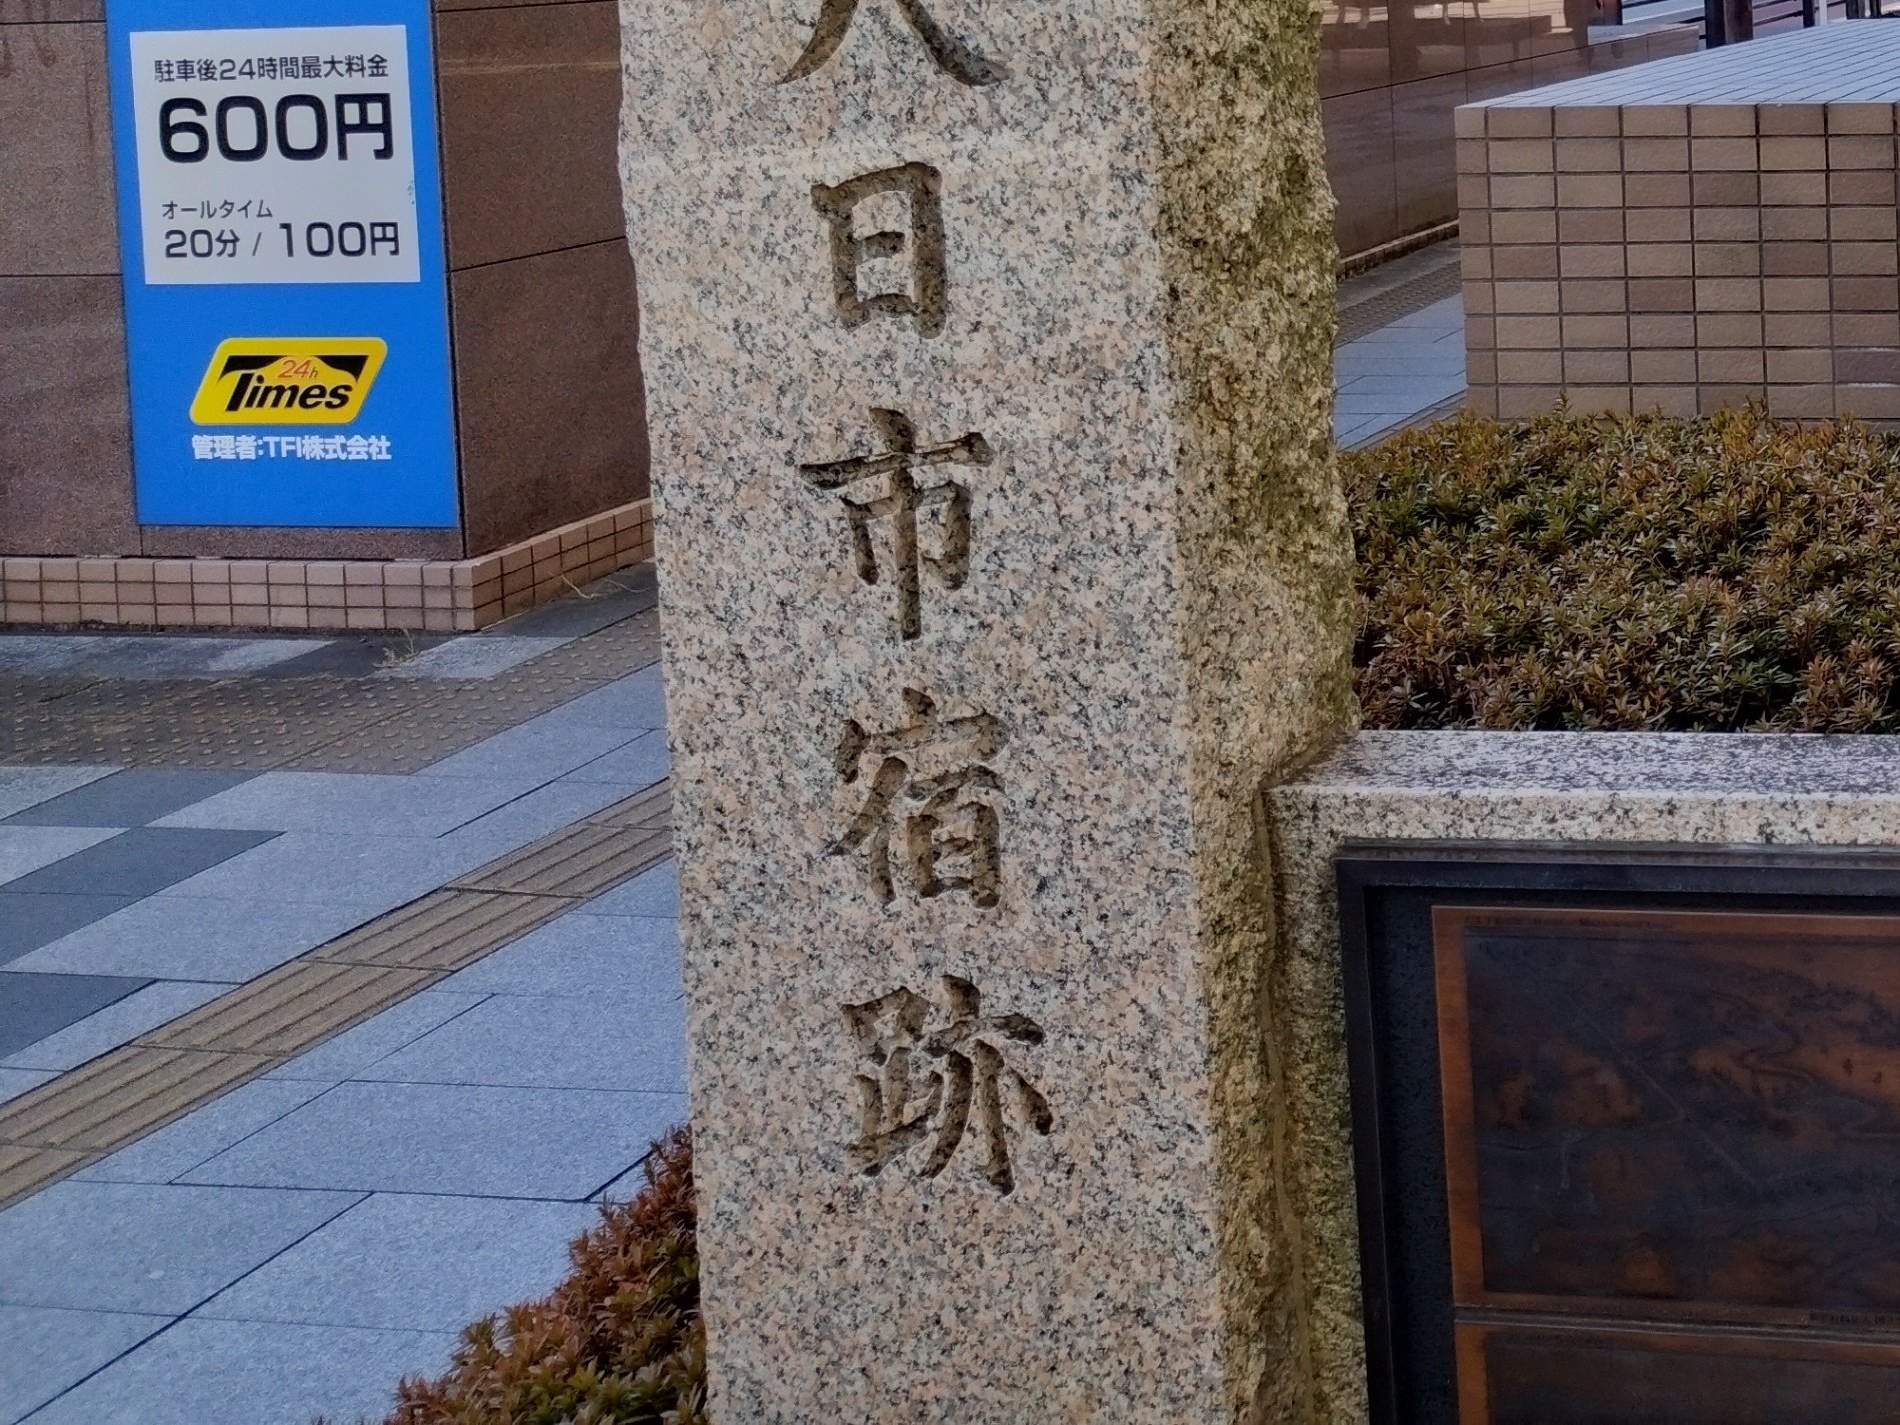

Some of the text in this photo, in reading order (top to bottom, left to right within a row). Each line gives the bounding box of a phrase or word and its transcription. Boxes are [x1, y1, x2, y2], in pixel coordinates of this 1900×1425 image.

[154, 54, 389, 84] 駐車後24時間最大料金
[159, 92, 394, 163] 600円
[161, 199, 273, 219] オールタイム
[217, 355, 369, 412] Times
[276, 360, 319, 380] 24h
